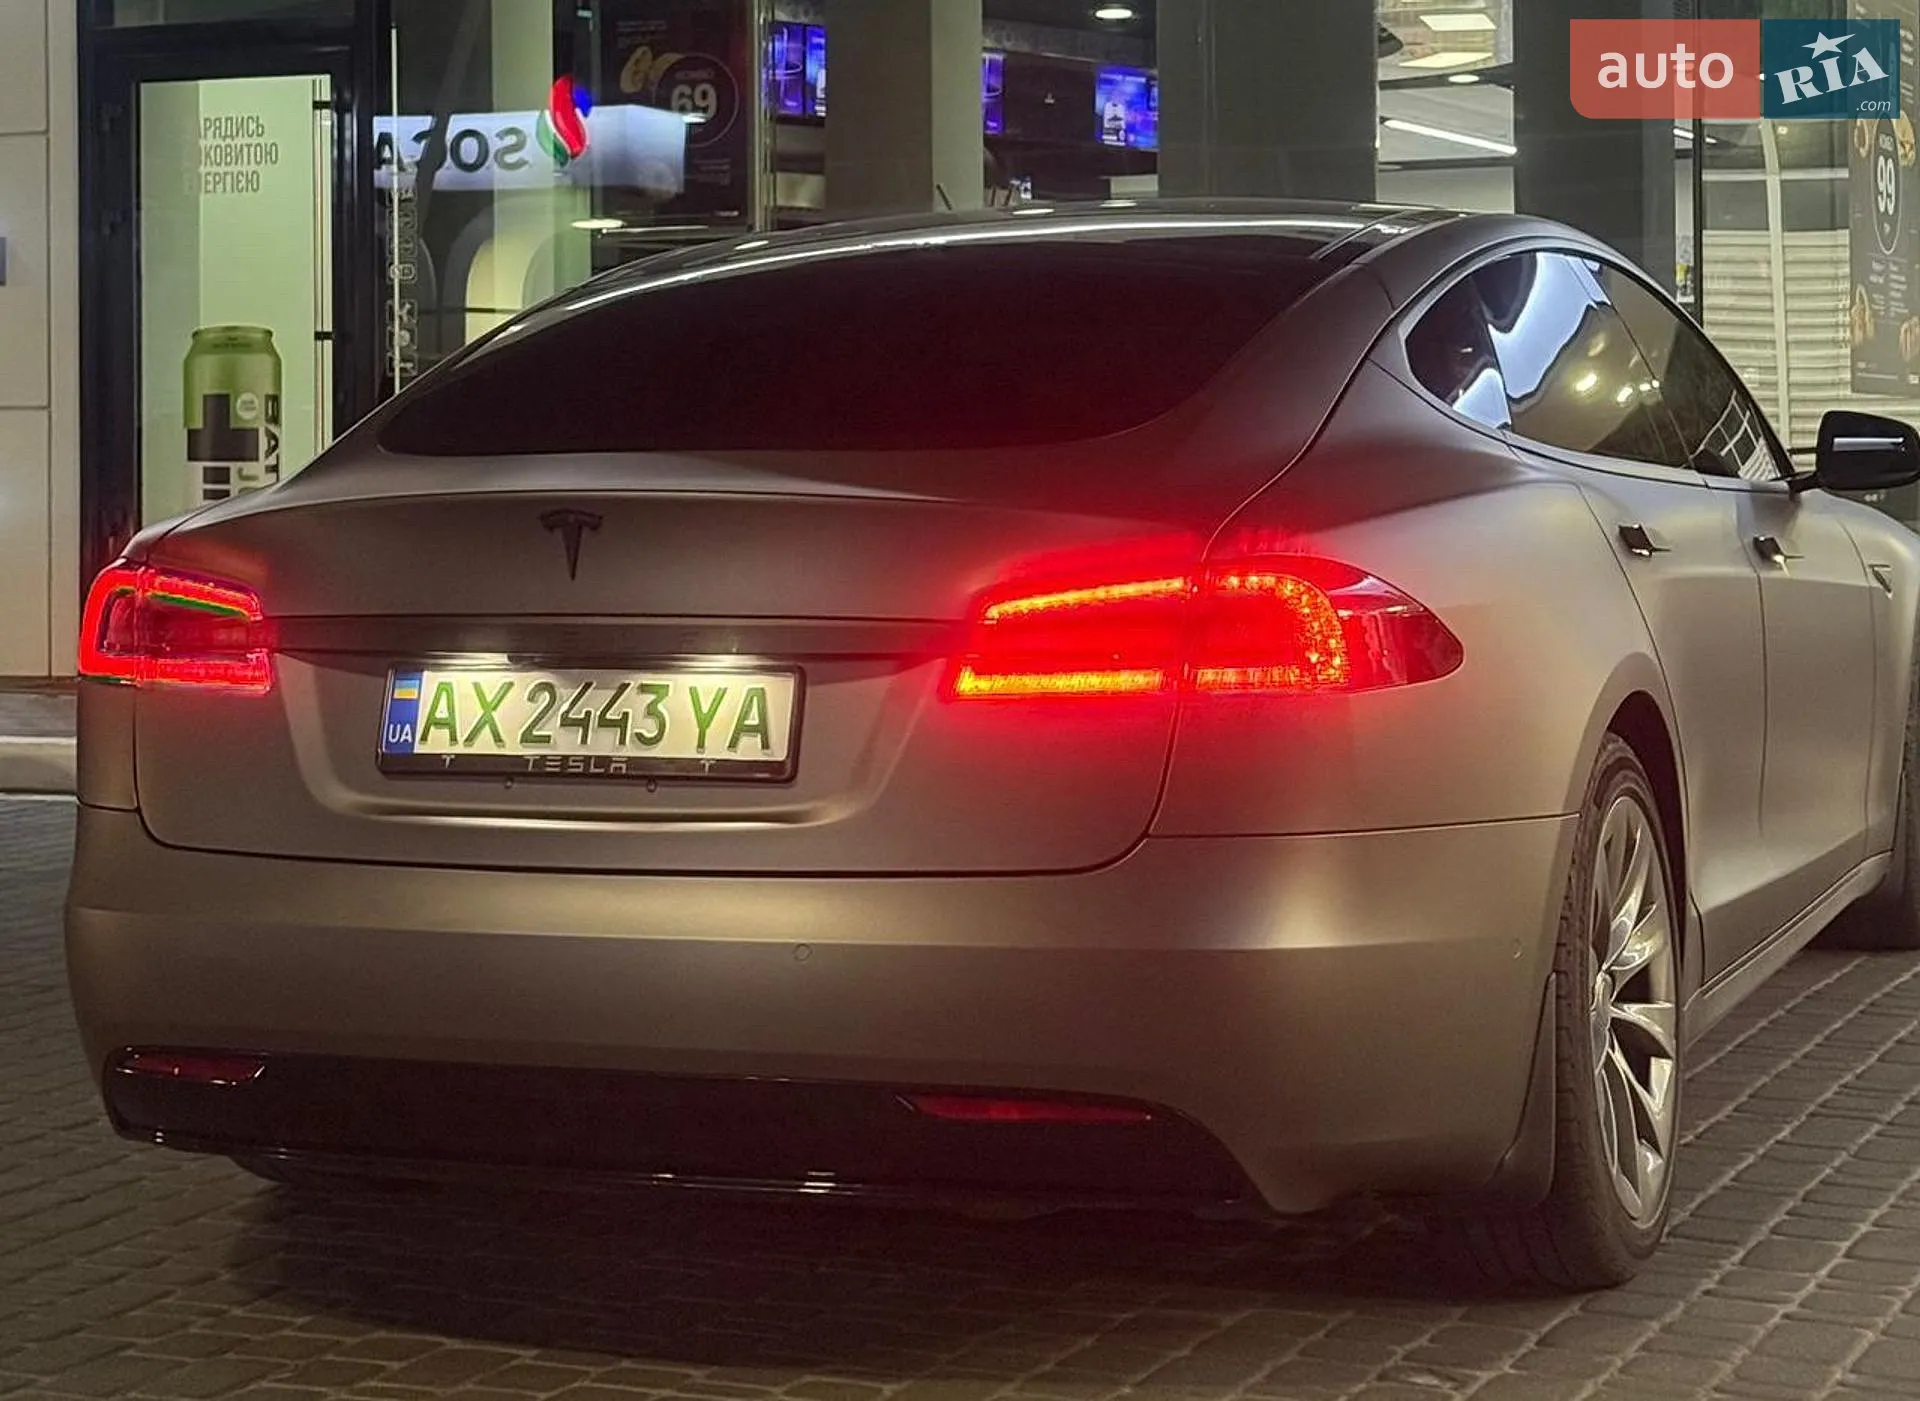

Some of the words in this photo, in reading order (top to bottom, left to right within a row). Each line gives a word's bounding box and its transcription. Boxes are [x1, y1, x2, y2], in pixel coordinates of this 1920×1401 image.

[671, 83, 718, 120] 69
[1877, 155, 1896, 216] 99
[388, 722, 414, 744] UA
[418, 681, 516, 748] AX
[518, 680, 671, 746] 2443
[688, 685, 776, 755] YA
[523, 755, 630, 775] TESLA
